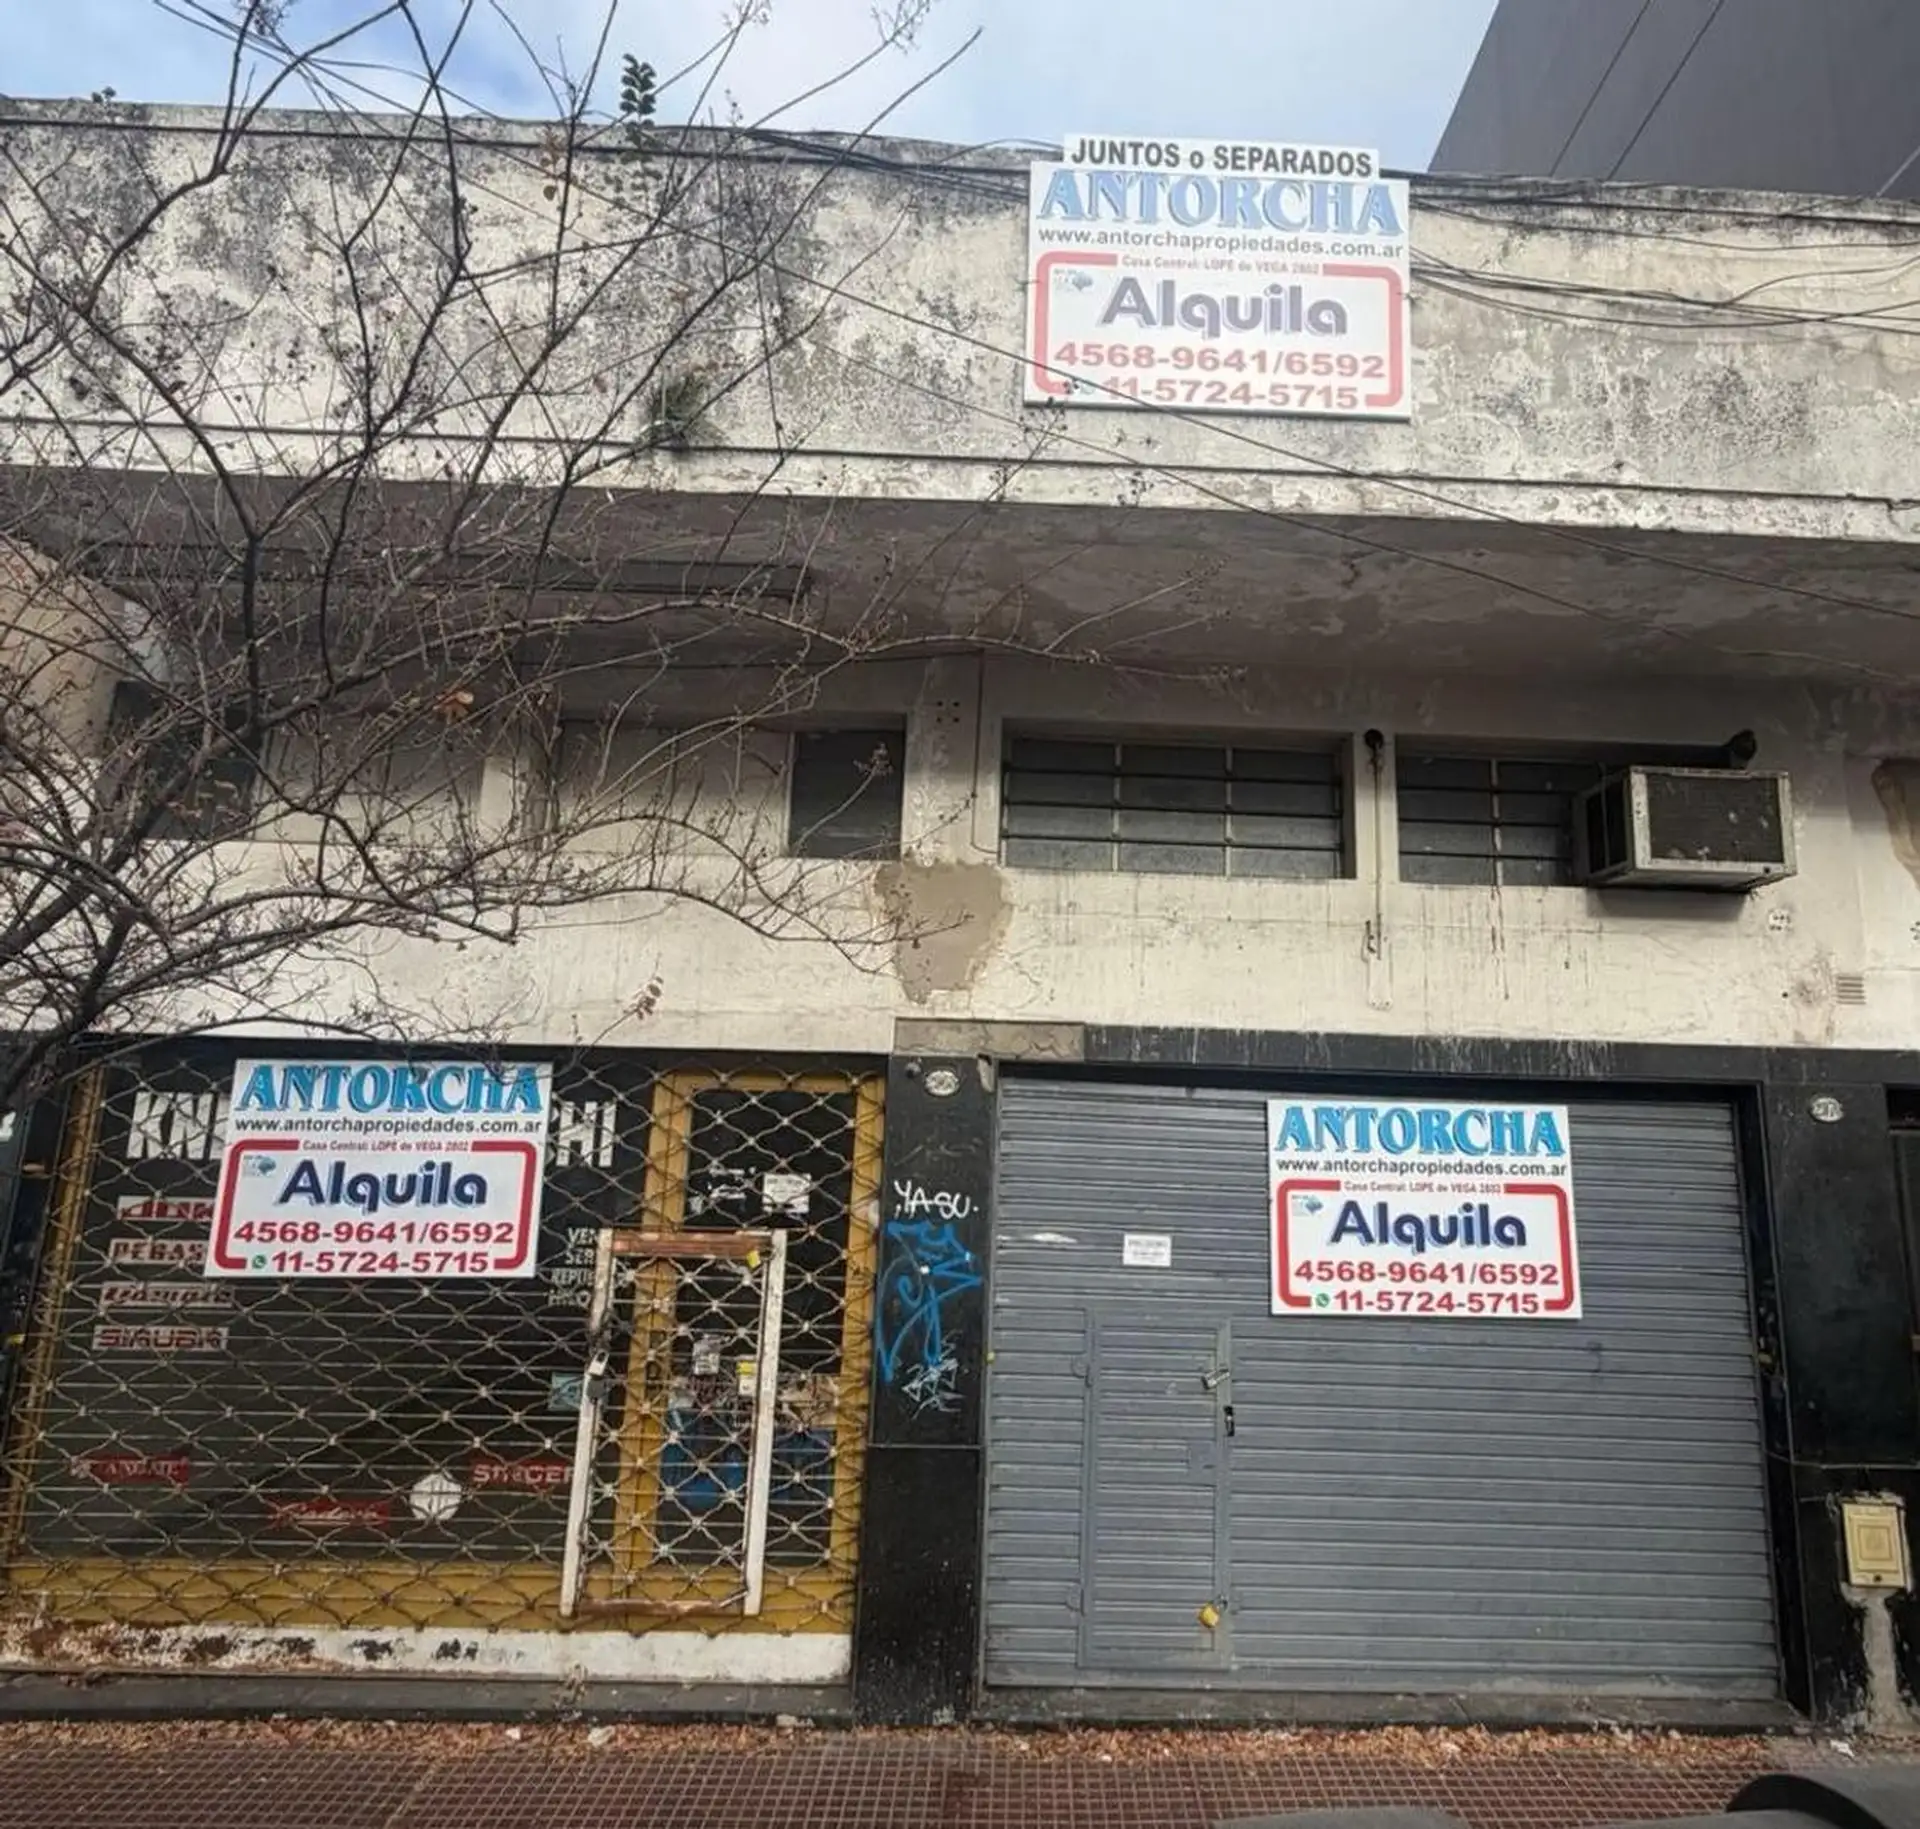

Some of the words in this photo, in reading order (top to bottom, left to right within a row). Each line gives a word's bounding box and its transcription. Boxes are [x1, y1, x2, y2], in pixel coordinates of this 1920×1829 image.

[1071, 138, 1180, 168] JUNTOS
[1190, 152, 1205, 168] o
[1214, 145, 1372, 178] SEPARADOS
[1036, 169, 1404, 236] ANTORCHA
[1038, 227, 1403, 259] www.antorchapropiedades.com.ar
[1100, 276, 1348, 340] Alquila
[1054, 342, 1386, 379] 4568-9641/6592
[1104, 375, 1359, 410] 11-5724-5715
[234, 1064, 543, 1114] ANTORCHA
[235, 1116, 542, 1136] www.antorchapropiedades.com.ar
[1274, 1106, 1566, 1157] ANTORCHA
[1277, 1157, 1567, 1177] www.antorchapropiedades.com.ar
[273, 1159, 488, 1216] Alquila
[234, 1221, 514, 1245] 4568-9641/6592
[1327, 1200, 1526, 1255] Alquila
[271, 1251, 489, 1274] 11-5724-5715
[1295, 1260, 1559, 1285] 4568-9641/6592
[1335, 1290, 1539, 1314] 11-5724-5715
